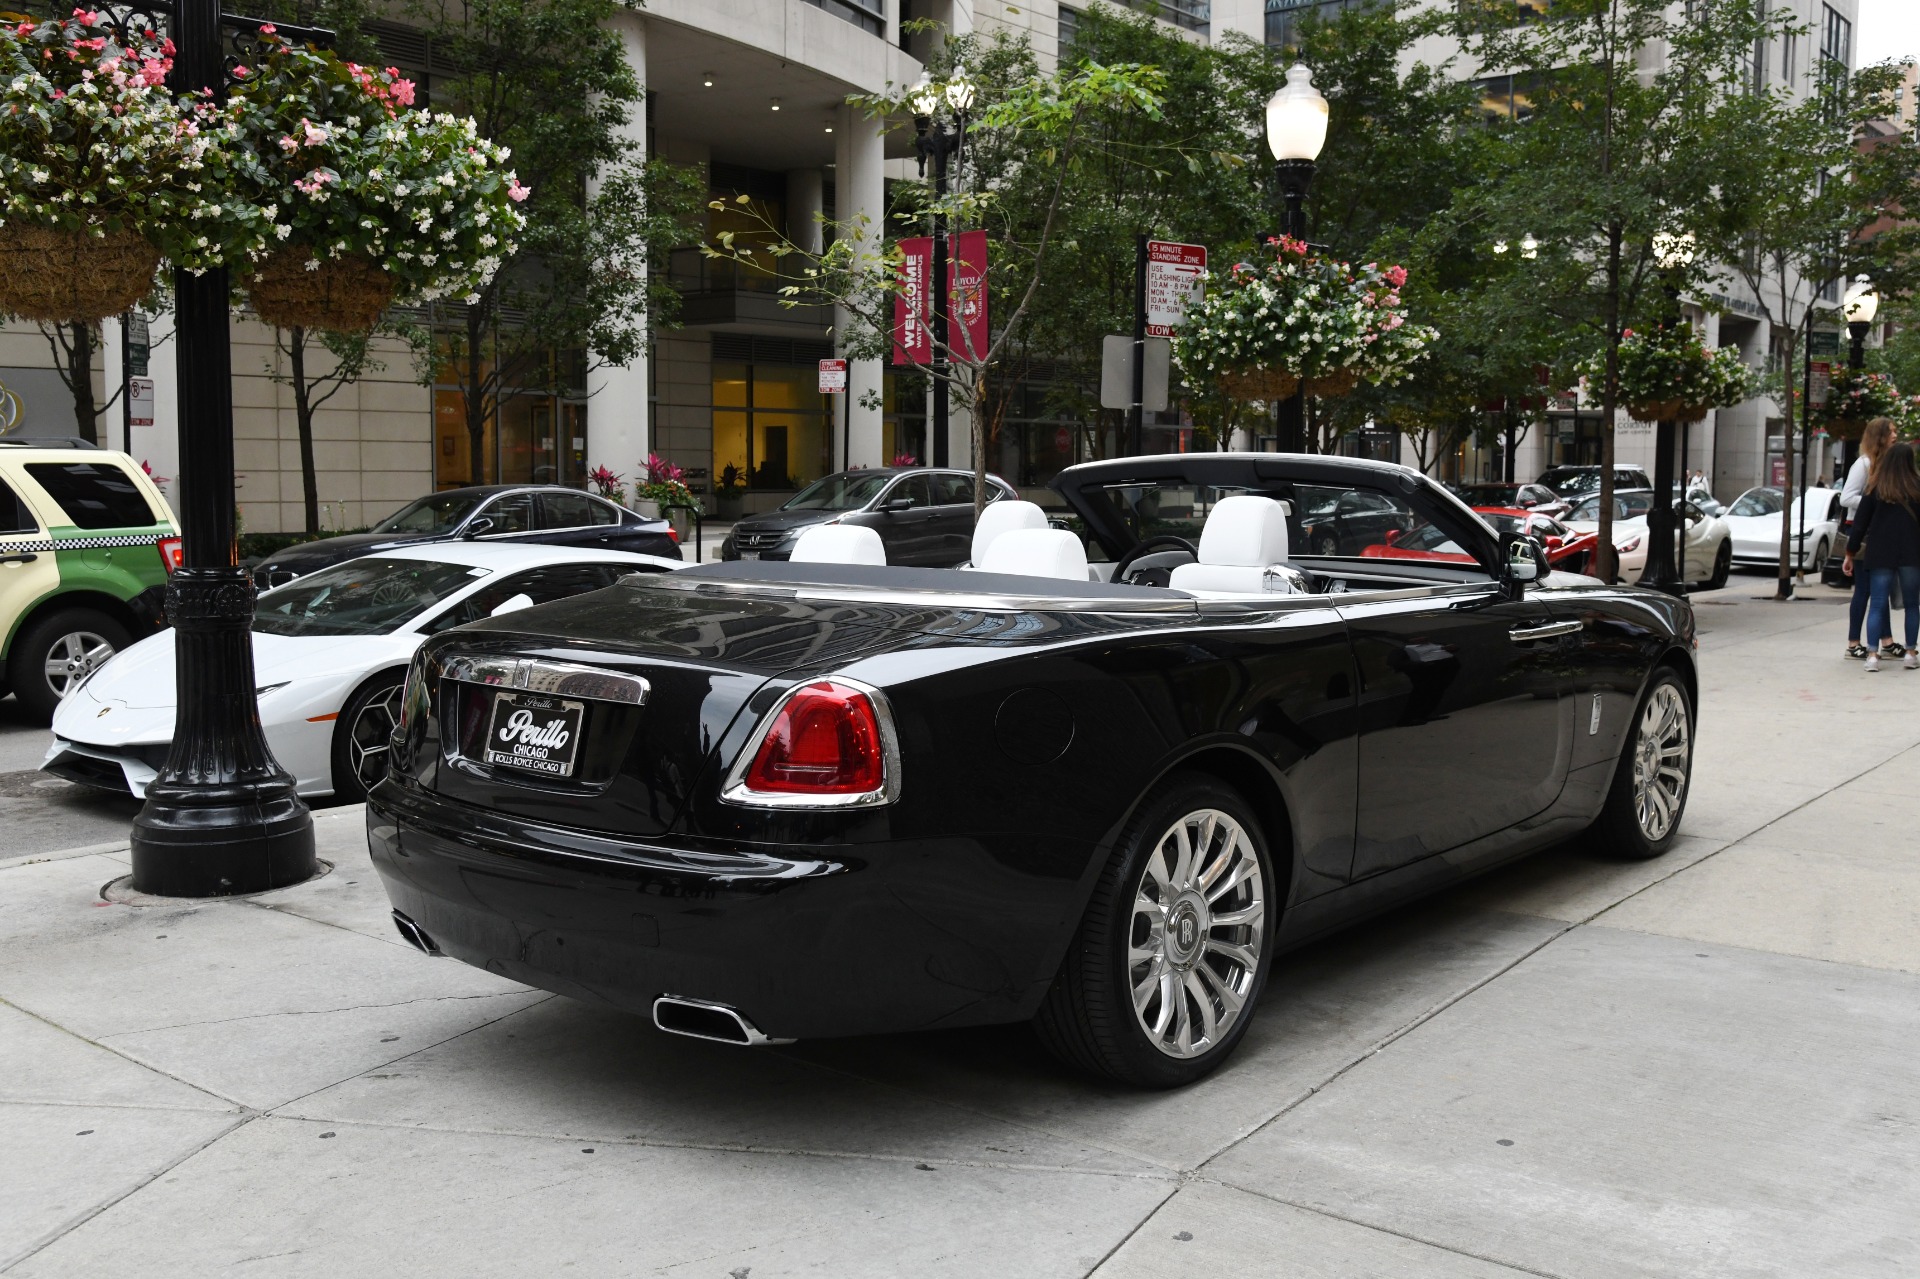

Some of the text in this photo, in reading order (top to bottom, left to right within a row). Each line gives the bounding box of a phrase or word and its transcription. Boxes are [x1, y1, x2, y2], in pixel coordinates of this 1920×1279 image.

[1160, 245, 1182, 254] MINUTE
[1152, 252, 1200, 264] STANDING ZONE
[1151, 265, 1164, 273] USE
[1151, 272, 1181, 283] FLASHING
[1151, 280, 1158, 288] 10
[1159, 281, 1169, 289] AM
[1180, 283, 1190, 291] PM
[1150, 288, 1165, 297] MON
[1150, 296, 1157, 304] 10
[1158, 297, 1168, 305] AM
[1173, 298, 1178, 306] 6
[1150, 304, 1161, 312] FRI
[1166, 305, 1180, 314] SUN
[1150, 325, 1170, 336] TOW
[524, 697, 553, 709] Perillo
[499, 709, 570, 750] Perillo
[513, 744, 548, 759] CHICAGO
[495, 754, 559, 772] ROLLS ROYCE CHICAGO
